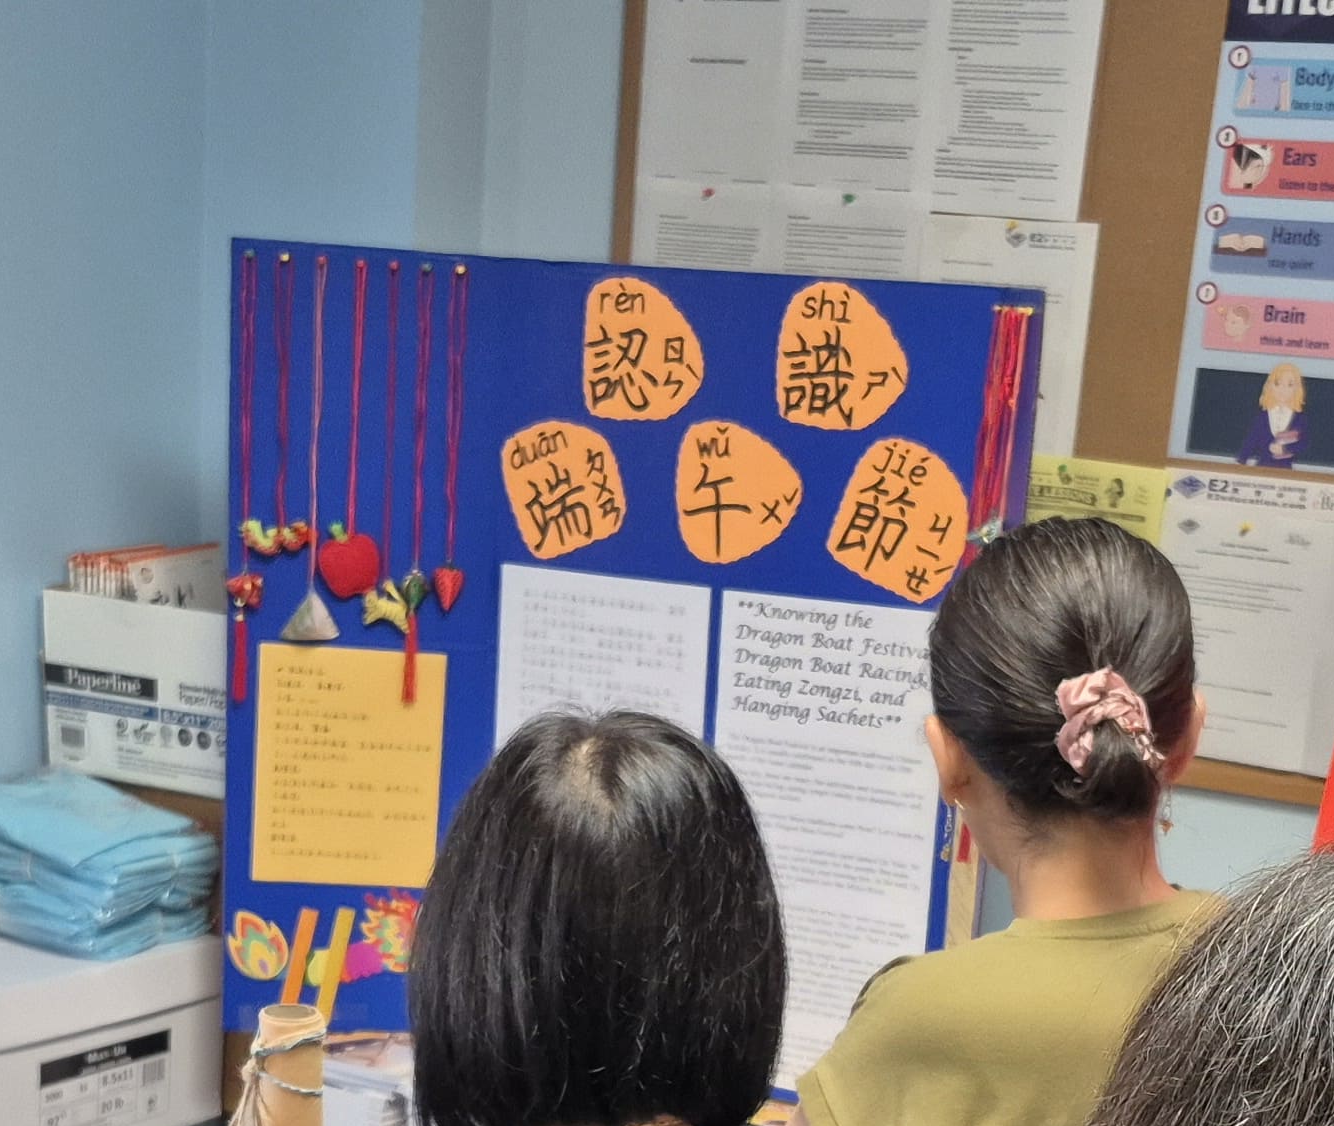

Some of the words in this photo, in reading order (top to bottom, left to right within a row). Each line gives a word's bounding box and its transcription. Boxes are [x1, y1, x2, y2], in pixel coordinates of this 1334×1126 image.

[1282, 147, 1317, 168] Ears
[1271, 227, 1321, 248] Hands
[598, 284, 646, 315] rèn
[801, 290, 851, 324] shì
[1264, 305, 1306, 326] Brain
[587, 325, 657, 411] 認
[782, 324, 854, 427] 識
[509, 428, 569, 470] duān
[871, 444, 930, 487] jié
[1208, 479, 1229, 493] E2
[525, 460, 594, 552] 端
[683, 463, 753, 557] 午
[835, 475, 917, 571] 節
[844, 610, 874, 630] the
[735, 624, 804, 647] Dragon
[811, 632, 853, 652] Boat
[858, 638, 932, 661] Festiva
[734, 648, 803, 673] Dragon
[810, 656, 851, 676] Boat
[66, 668, 142, 695] Paperline
[733, 672, 793, 697] Eating
[797, 680, 864, 705] Zongzi,
[869, 690, 907, 708] and
[731, 696, 811, 725] Hanging
